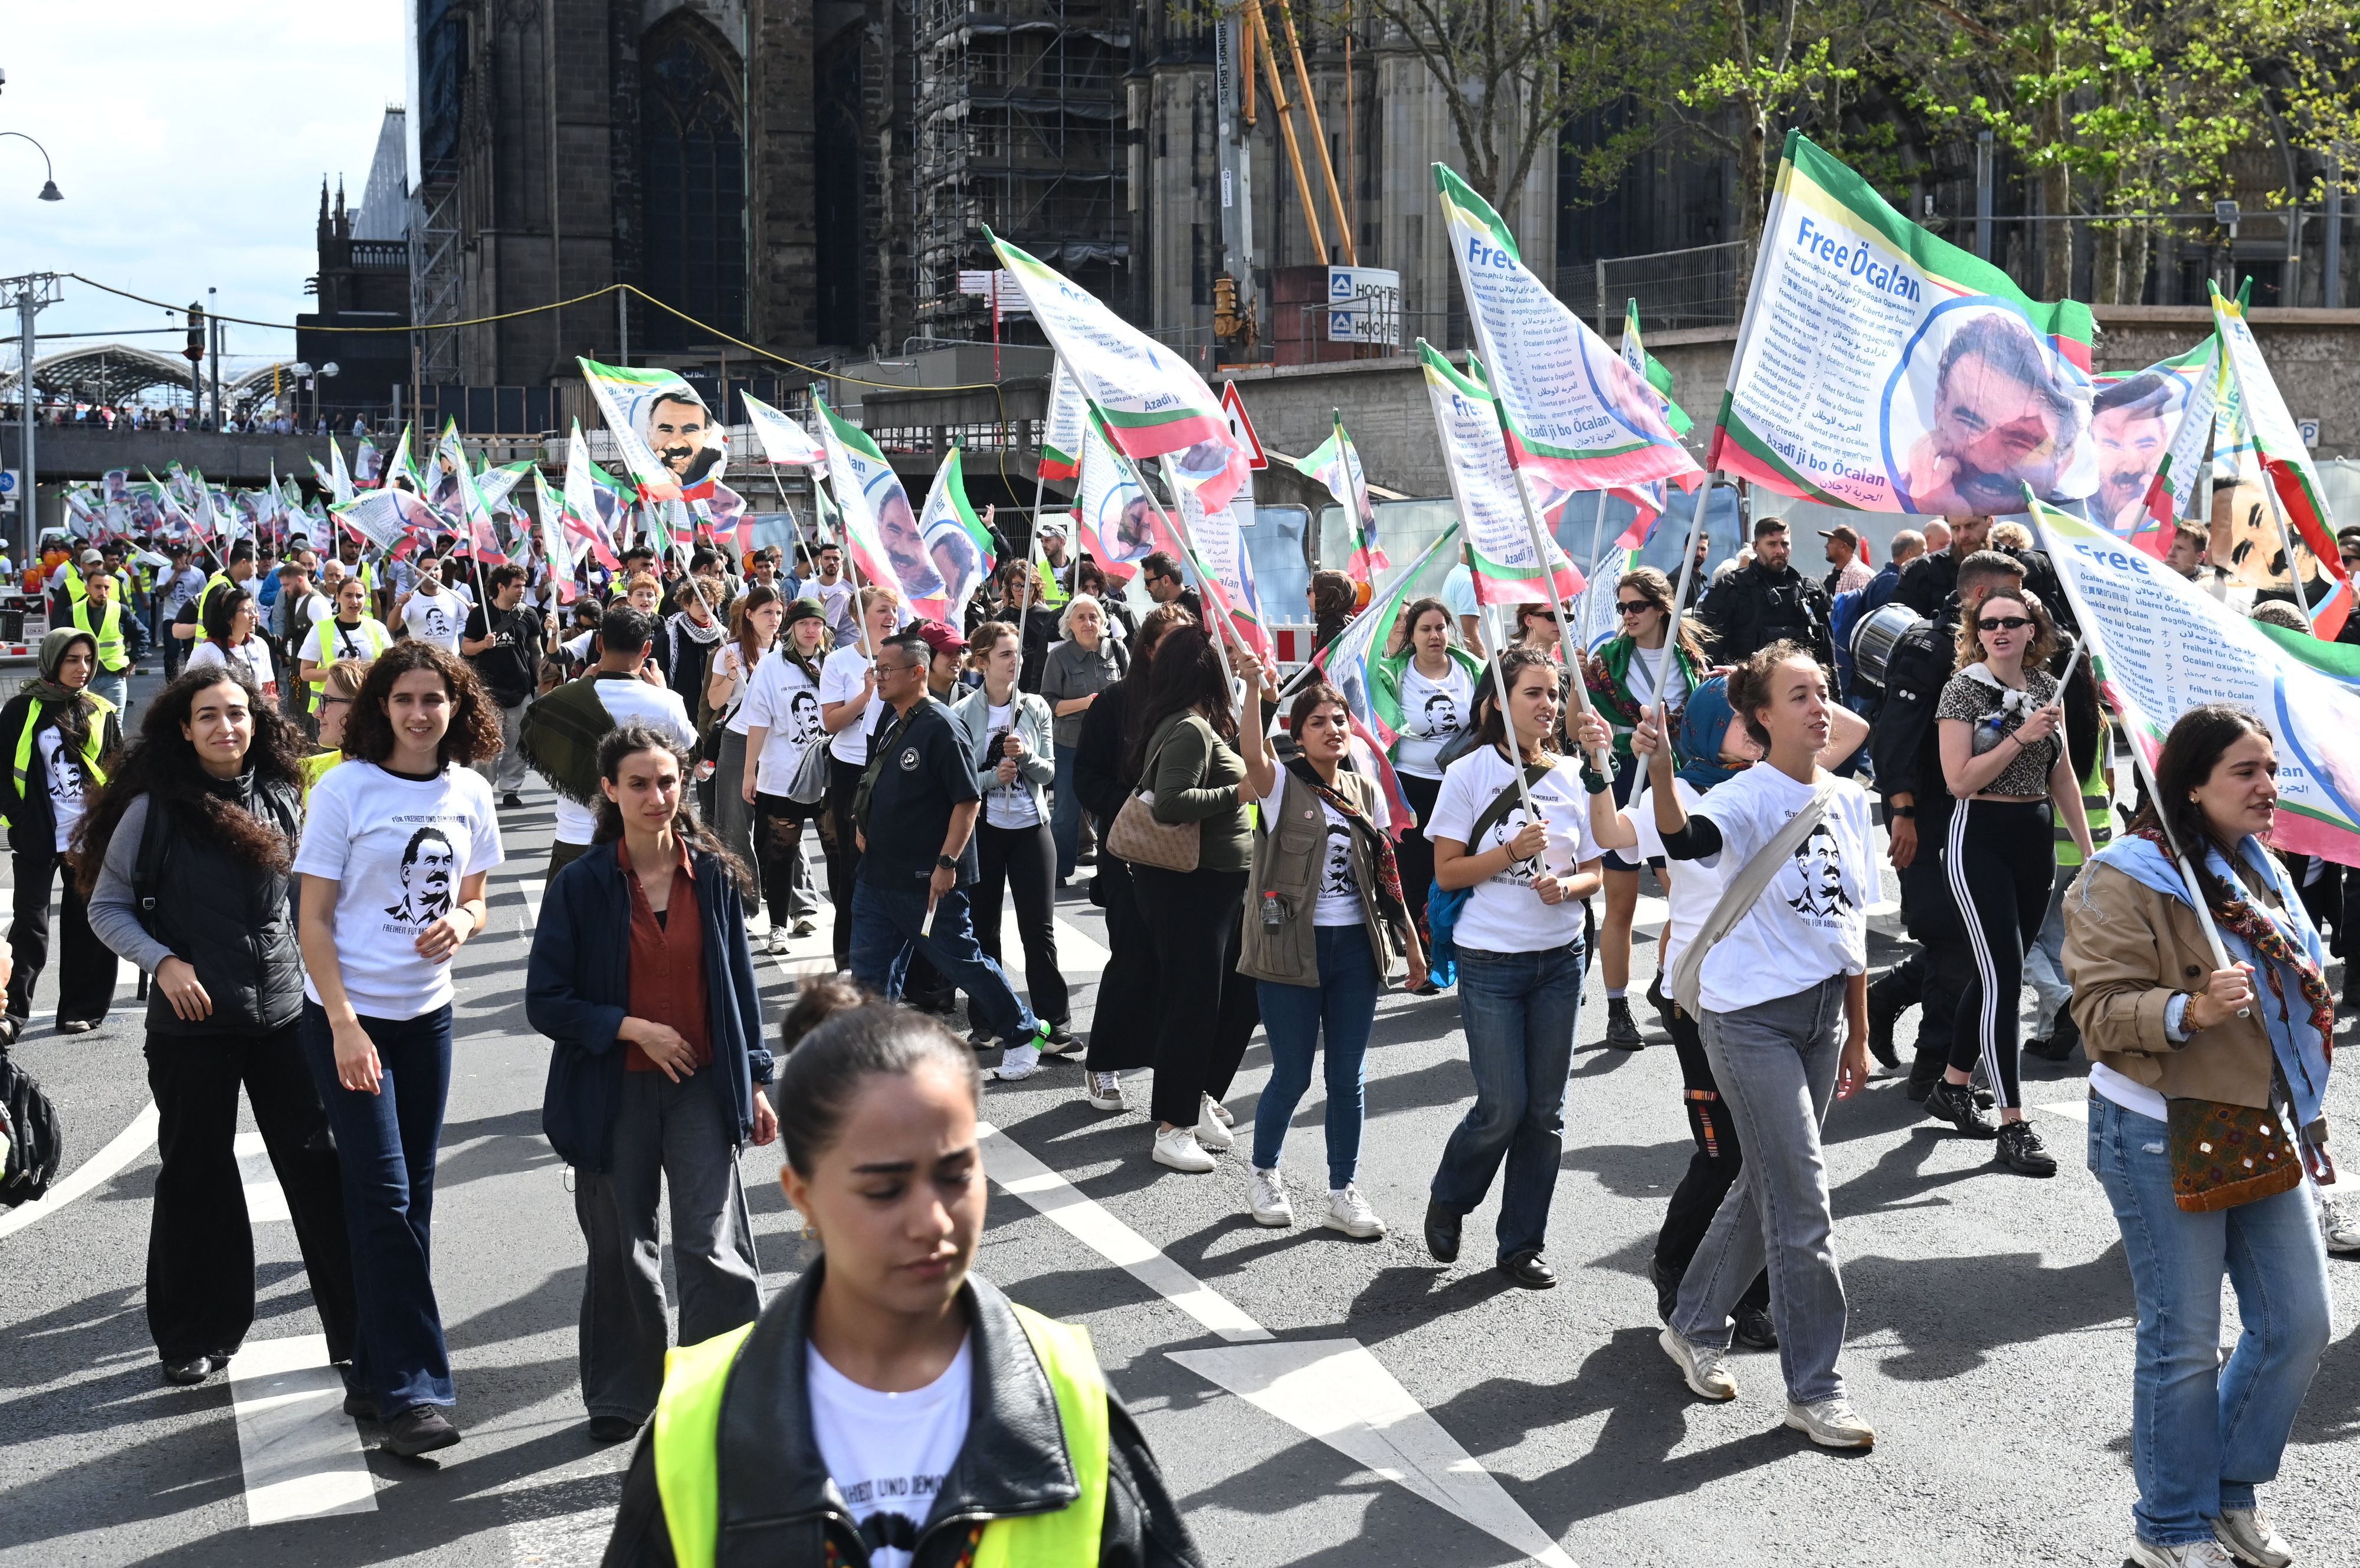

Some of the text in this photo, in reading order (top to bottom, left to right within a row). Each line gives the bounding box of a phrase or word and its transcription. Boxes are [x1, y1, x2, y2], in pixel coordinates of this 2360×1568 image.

[1797, 216, 1920, 303] Free Öcalan
[1784, 261, 1818, 288] Öcalan askatu
[1779, 287, 1821, 317] Frankiz evit Ocalan
[1853, 285, 1916, 316] Свобода Оджалану
[1775, 300, 1798, 320] Libertate
[1806, 319, 1820, 331] Ocalan
[1863, 305, 1883, 318] Libertà
[1895, 314, 1912, 327] Öcalan
[1552, 324, 1568, 333] Öcalan
[1769, 324, 1791, 343] Vapautta
[1626, 346, 1641, 375] Free
[1762, 349, 1805, 379] Vrijheid voor Öcalan
[1792, 354, 1806, 366] Ocalan
[1831, 342, 1847, 357] Freiheit
[1856, 355, 1875, 367] Öcalan
[1532, 362, 1547, 371] Frihet
[1556, 359, 1572, 368] Öcalan
[1532, 370, 1575, 382] Öcalan'a Özgürlük
[1758, 360, 1802, 391] Libertad para Öcalan
[1748, 381, 1794, 413] Liberdade para Öcalan
[1753, 371, 1800, 404] Scaoileadh saor Öcalan
[1823, 382, 1864, 405] Frihet för Öcalan
[1145, 392, 1172, 412] Azadî
[1538, 398, 1558, 408] Llibertat
[1572, 393, 1587, 402] Ocalan
[1817, 393, 1863, 418] Öcalan'a Özgürlük
[1525, 414, 1611, 441] Azadî ji bo Öcalan
[1733, 399, 1804, 441] Ελευθερία στον Οτσαλάν
[1804, 421, 1828, 437] Llibertat
[1829, 432, 1839, 441] per
[1846, 437, 1869, 448] Ocalan
[2303, 426, 2315, 445] P
[1766, 433, 1885, 487] Azadî ji bo Öcalan
[1505, 546, 1533, 566] Azadî ji
[2080, 572, 2130, 591] Öcalan askatu
[2107, 604, 2122, 613] evit
[2124, 608, 2149, 619] Ocalan
[2136, 598, 2191, 616] Libérez Öcalan
[2115, 619, 2152, 634] lui Ocalan
[2116, 641, 2151, 658] Öcalanille
[2182, 642, 2255, 665] Freiheit für Öcalan
[2124, 656, 2147, 670] Ocalan
[2129, 668, 2153, 684] Öcalan
[2132, 680, 2155, 694] Öcalan
[2189, 684, 2254, 700] Frihet för Öcalan
[2139, 699, 2162, 714] Öcalan
[2140, 691, 2164, 706] Öcalan
[1530, 793, 1559, 802] DEMOKRATIE
[392, 815, 404, 824] FÜR
[382, 924, 418, 935] FREIHEIT FÜR
[1812, 918, 1822, 927] FÜR
[877, 1477, 909, 1497] UND
